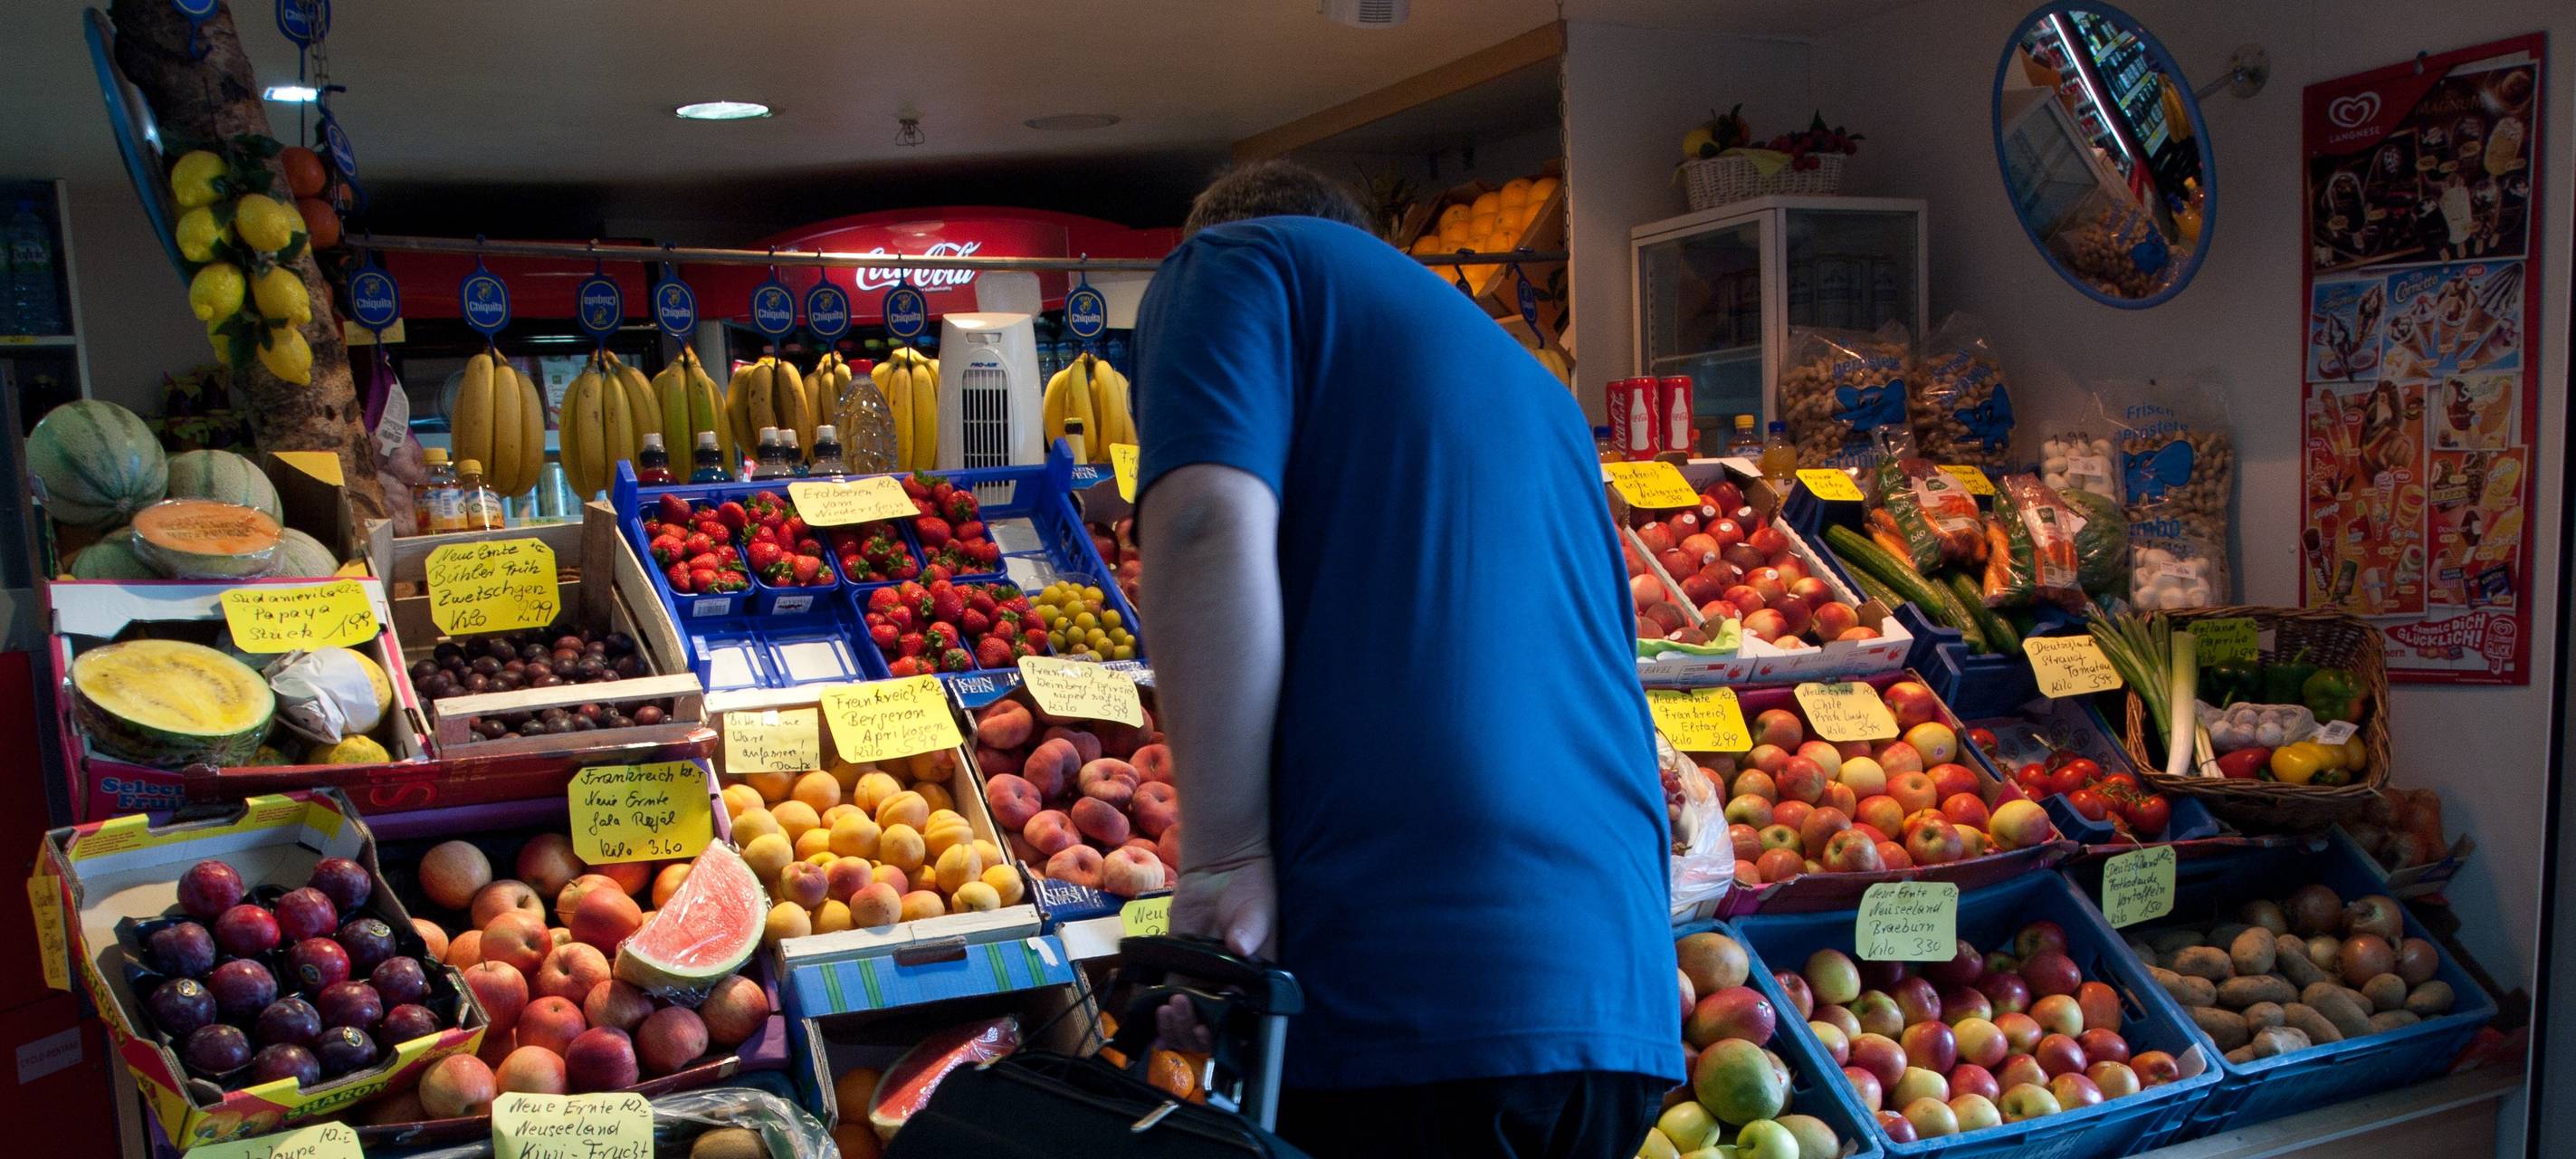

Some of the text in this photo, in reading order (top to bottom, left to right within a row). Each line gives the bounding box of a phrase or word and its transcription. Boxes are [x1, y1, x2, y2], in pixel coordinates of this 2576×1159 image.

[2330, 125, 2380, 143] LANGNESE
[357, 297, 393, 312] Chiquita
[469, 300, 503, 314] Chiquita
[661, 307, 692, 320] Chiquita
[758, 308, 791, 321] Chiquita
[812, 311, 844, 323] Chiquita
[891, 311, 921, 324] Chiquita
[1072, 313, 1101, 324] Chiquita
[804, 488, 872, 499] Erdbeeren
[1911, 530, 1926, 543] bio
[436, 548, 473, 563] Neue
[429, 563, 495, 587] Bühler
[439, 580, 548, 607] Zwetschgen
[254, 606, 330, 623] Papaya
[451, 608, 487, 631] Kilo
[250, 624, 313, 640] Stück
[2064, 661, 2111, 678] Tomaten
[960, 685, 995, 694] FEIN
[2052, 679, 2073, 694] Kilo
[830, 685, 918, 709] Frankreich
[1653, 693, 1678, 704] Neue
[1813, 697, 1842, 713] Chile
[1049, 701, 1077, 712] Kilo
[1659, 704, 1726, 721] Frankreich
[1681, 721, 1719, 732] Elstar
[1827, 723, 1846, 735] Kilo
[732, 731, 763, 742] Ware
[863, 723, 949, 747] Aprikosen
[1672, 733, 1692, 744] Kilo
[854, 745, 883, 760] Kilo
[581, 765, 674, 785] Frankreich
[586, 790, 669, 808] Neue Ernte
[588, 812, 620, 836] Gala
[600, 838, 682, 857] Kilo 3.60
[1047, 885, 1078, 896] FEIN
[1134, 906, 1170, 924] Neu
[1869, 901, 1942, 917] Neuseeland
[1870, 918, 1934, 936] Braeburn
[1868, 939, 1895, 958] Kilo
[283, 1081, 388, 1121] SHARON
[510, 1097, 556, 1115] Neue
[563, 1099, 615, 1116] Ernte
[515, 1117, 621, 1137] Neuseeland
[520, 1141, 566, 1159] Kiwi
